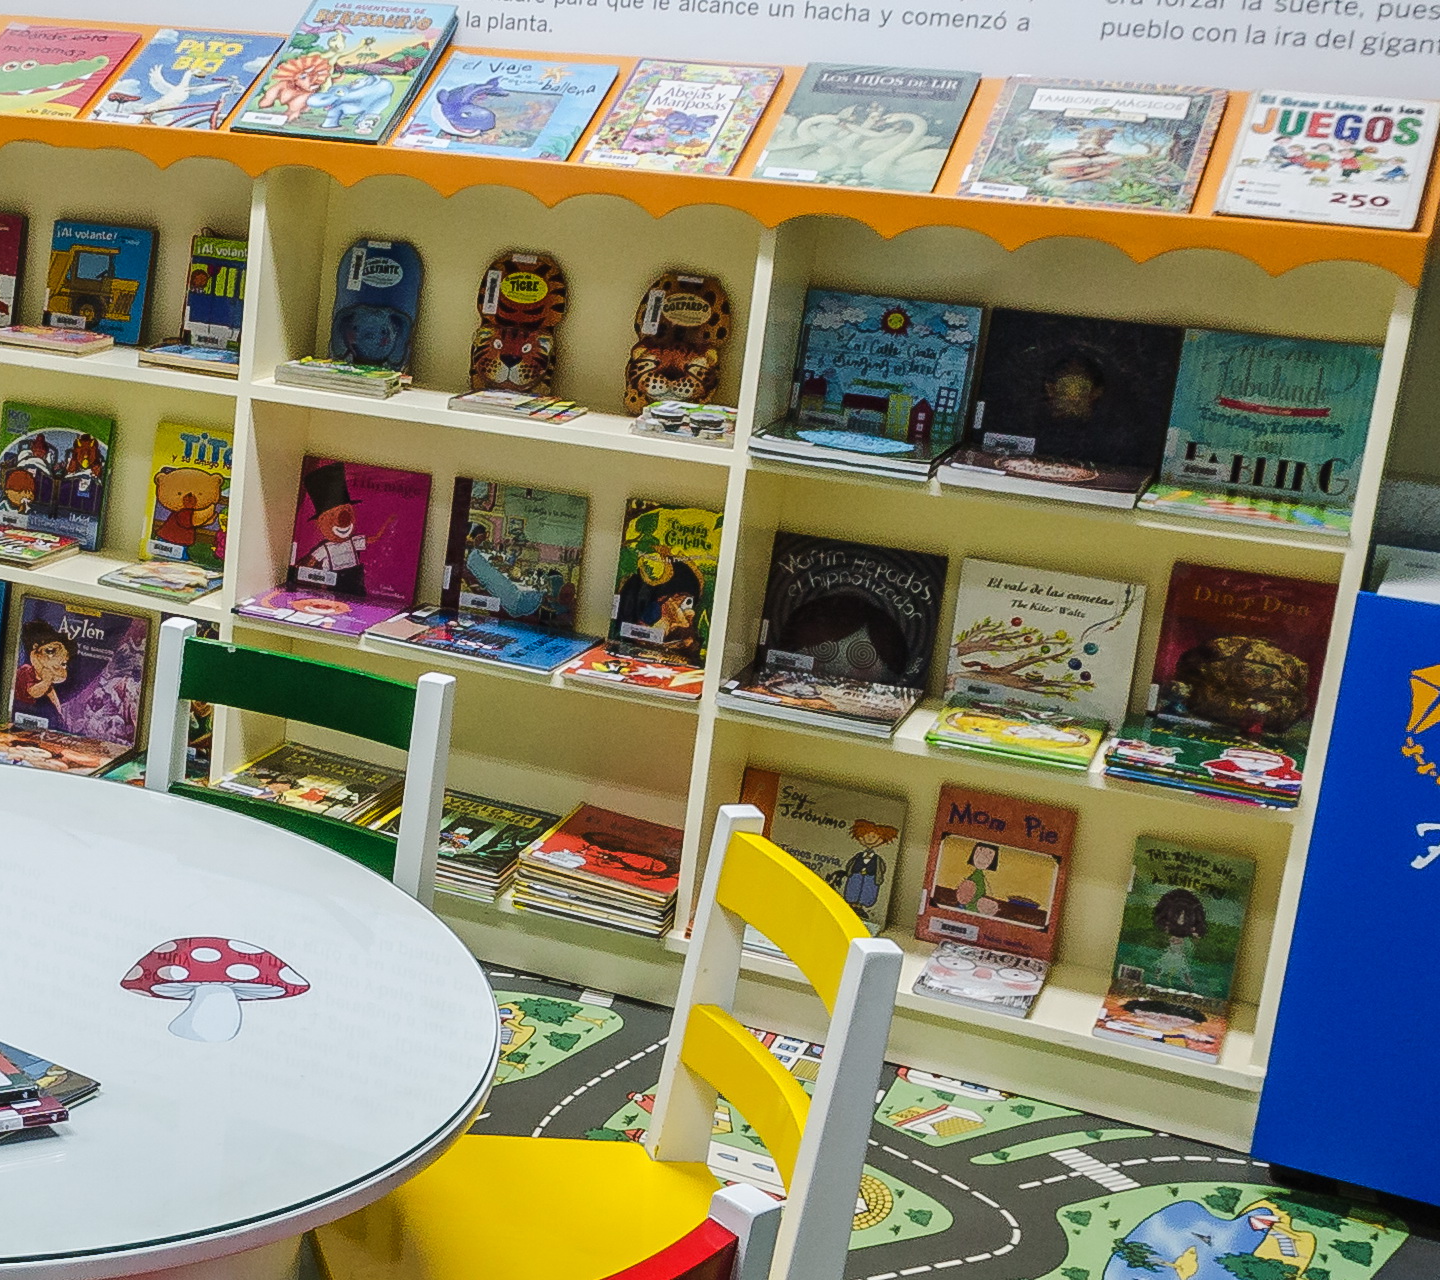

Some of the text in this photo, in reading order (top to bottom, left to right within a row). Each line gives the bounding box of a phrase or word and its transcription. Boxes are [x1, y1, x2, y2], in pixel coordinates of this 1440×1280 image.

[333, 2, 353, 11] LAS
[354, 4, 407, 13] AVENTURAS
[174, 36, 244, 58] PATO
[488, 63, 532, 75] Viaje
[541, 80, 597, 97] ballena
[852, 74, 904, 87] HIJOS
[665, 86, 715, 100] Abejas
[1037, 93, 1111, 108] TAMBORES
[652, 96, 727, 113] Mariposas
[1279, 96, 1321, 110] Gran
[1324, 98, 1366, 112] Libro
[1251, 107, 1424, 146] JUEGOS
[1330, 191, 1390, 209] 250
[75, 229, 119, 242] volante!
[216, 246, 247, 258] volant
[778, 549, 846, 575] Martín
[810, 568, 923, 621] hipnotizador
[987, 577, 1115, 606] El vals de las cometas
[1011, 598, 1028, 609] The
[57, 616, 105, 641] Aylén
[948, 802, 1060, 845] Mom Pie
